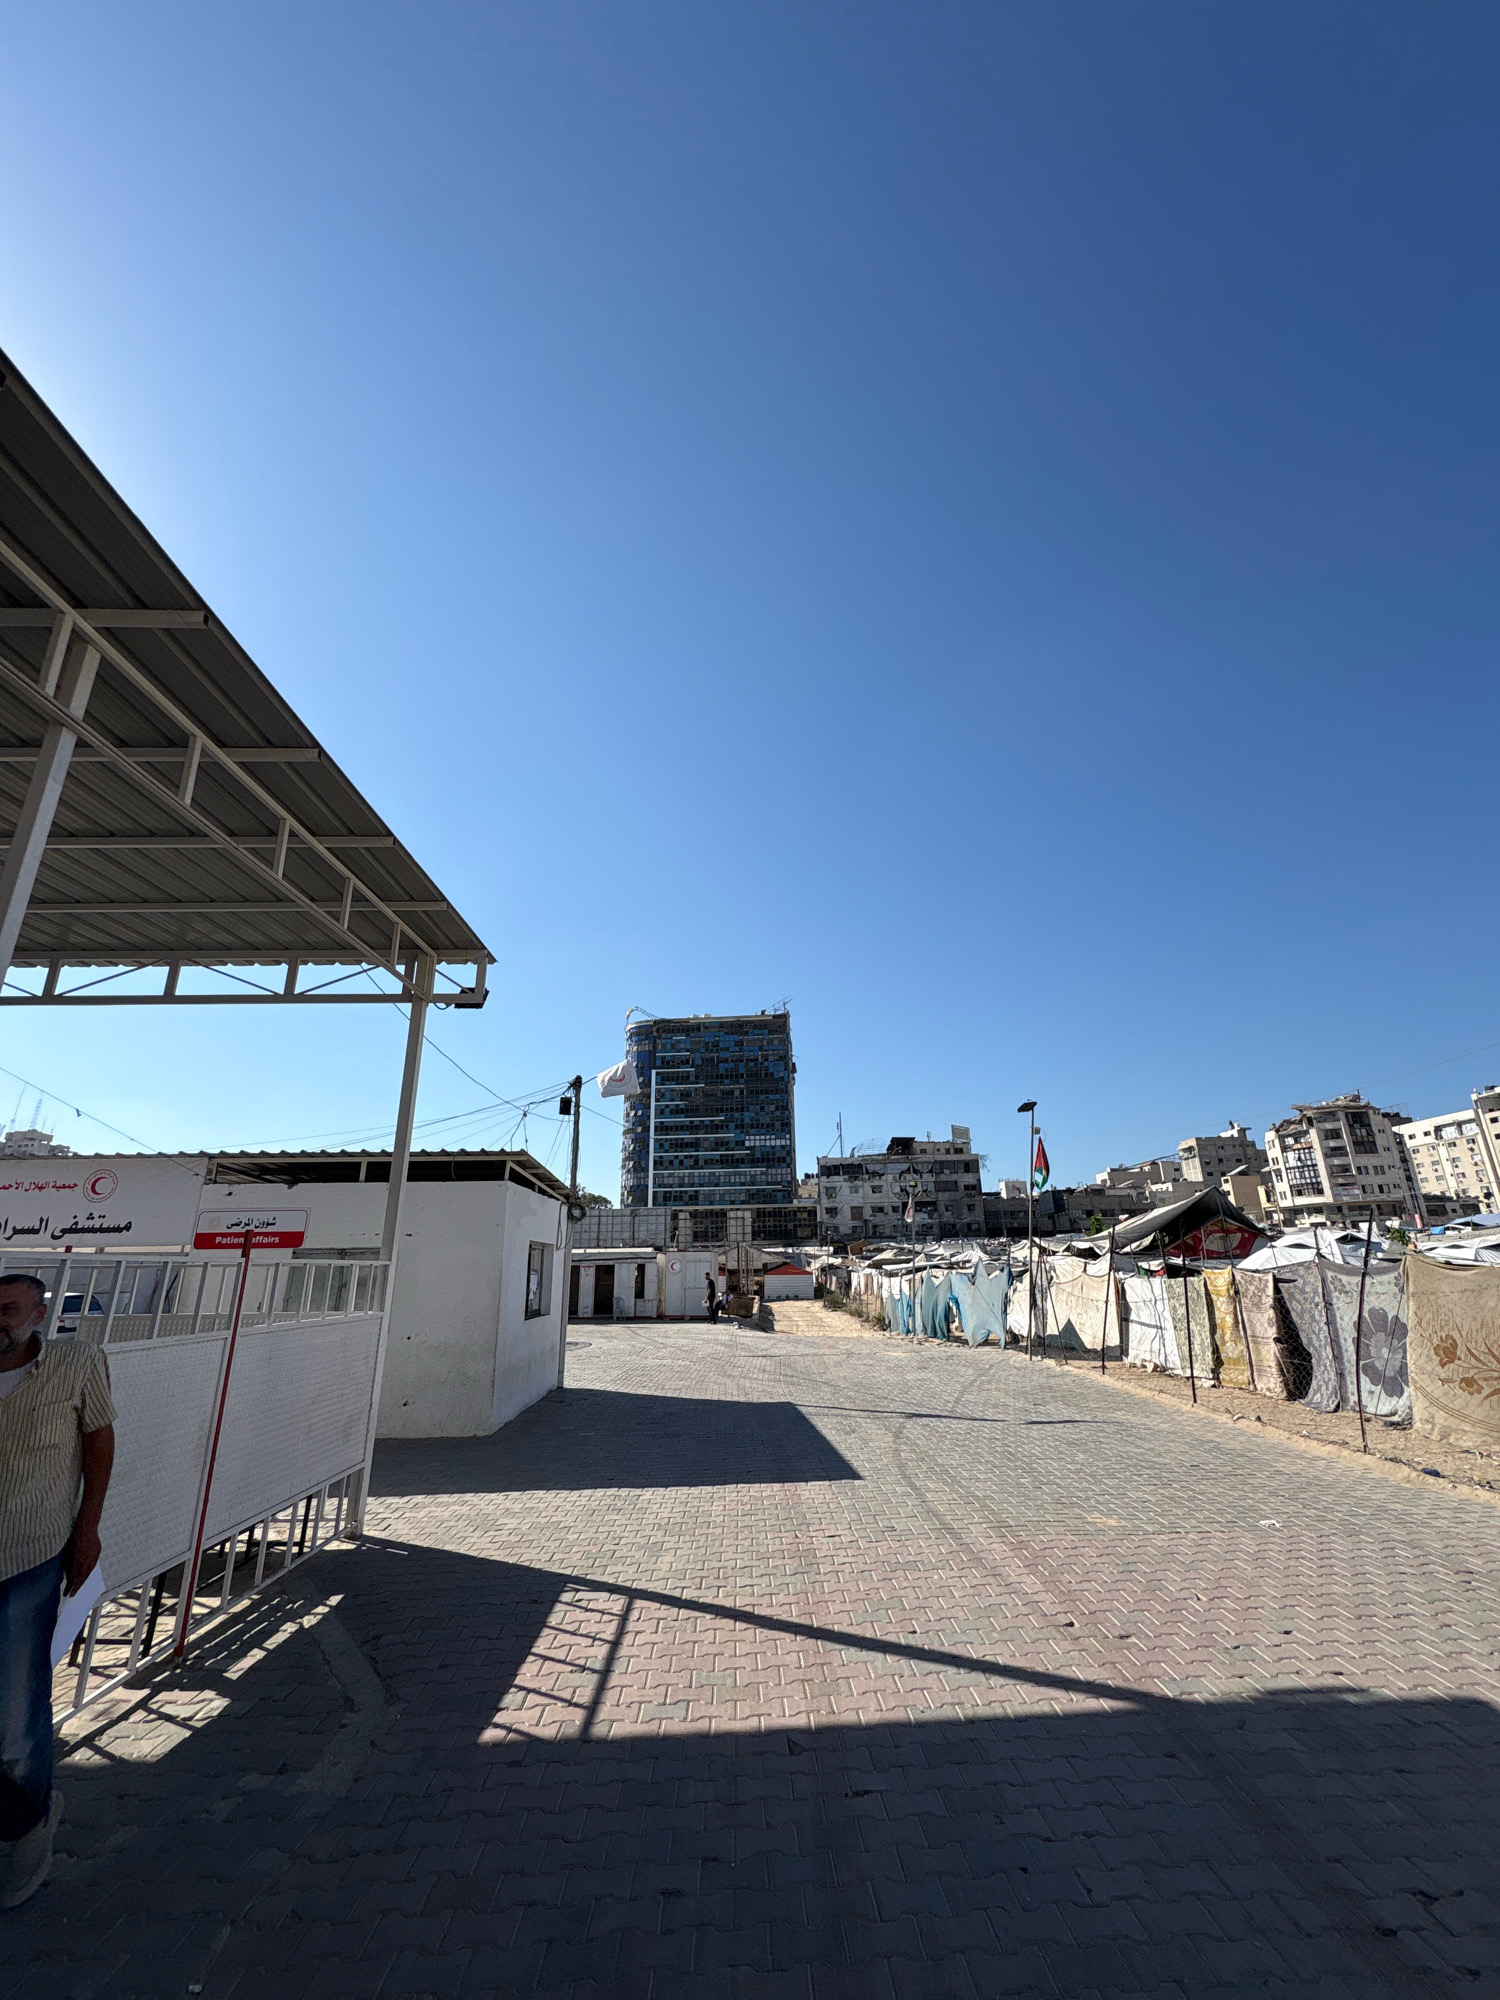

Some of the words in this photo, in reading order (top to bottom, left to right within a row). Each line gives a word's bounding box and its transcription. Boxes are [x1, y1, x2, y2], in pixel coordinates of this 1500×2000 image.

[0, 1178, 24, 1190] الأحم
[24, 1180, 50, 1192] الهلال
[51, 1180, 79, 1192] جمعية
[0, 1216, 50, 1241] السرا
[50, 1212, 133, 1240] مستشفى
[226, 1216, 254, 1229] المرضى
[254, 1216, 277, 1229] شؤون
[215, 1235, 245, 1244] Patien
